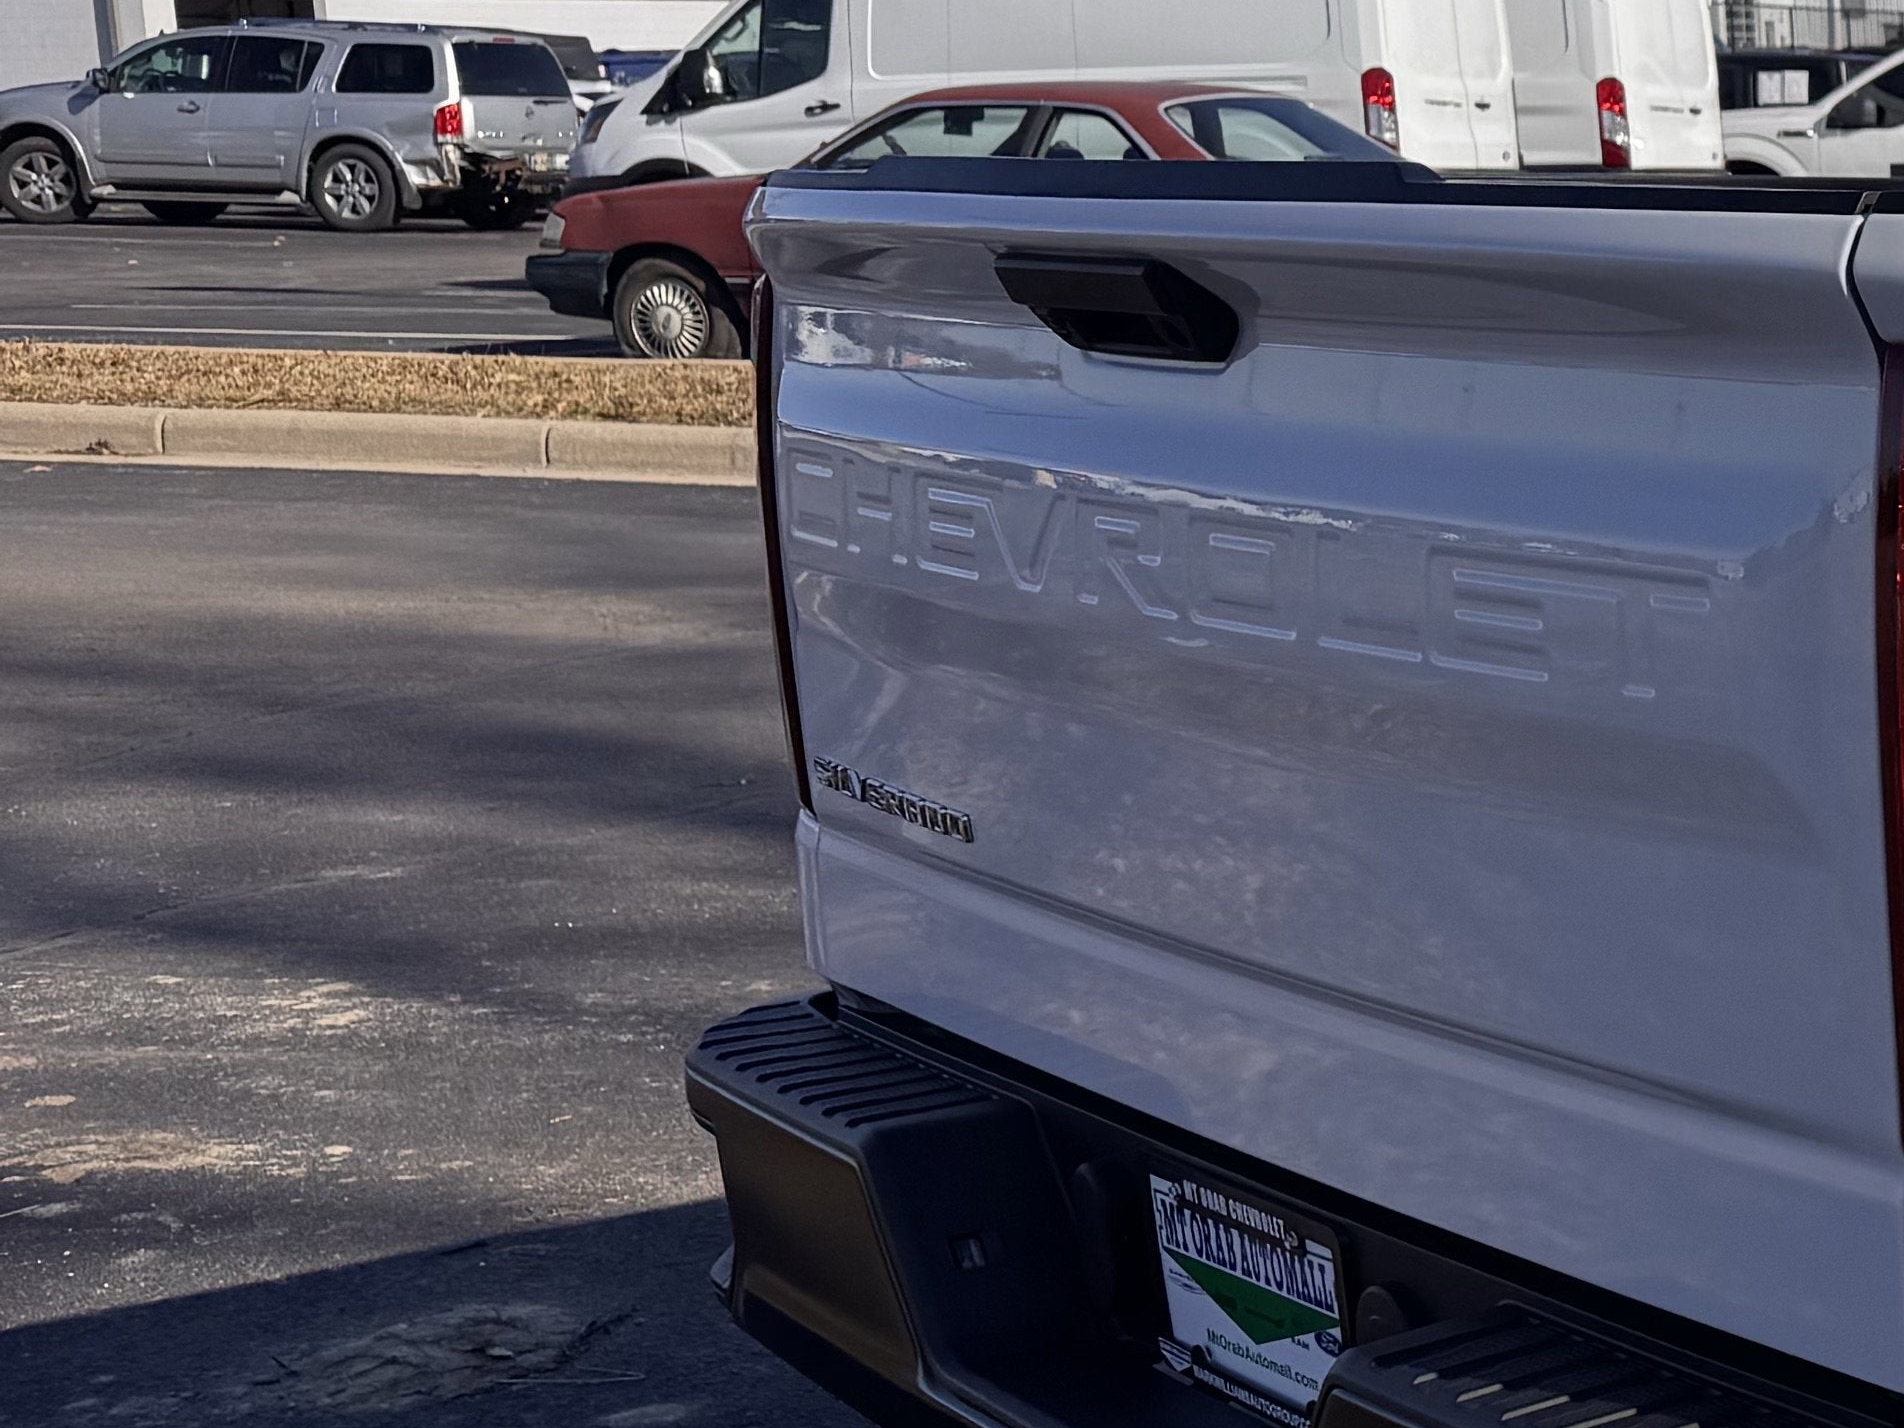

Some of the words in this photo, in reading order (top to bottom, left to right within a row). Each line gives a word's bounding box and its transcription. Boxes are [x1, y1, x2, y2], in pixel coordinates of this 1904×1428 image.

[785, 446, 1712, 699] CHEVROLET
[813, 755, 975, 844] SILVERADO
[1160, 1198, 1191, 1252] MT
[1191, 1214, 1238, 1273] ORAB
[1241, 1238, 1335, 1312] AUTOMALL
[1183, 1179, 1198, 1204] MT
[1199, 1185, 1228, 1217] ORAB
[1228, 1198, 1286, 1238] CHEVROLET
